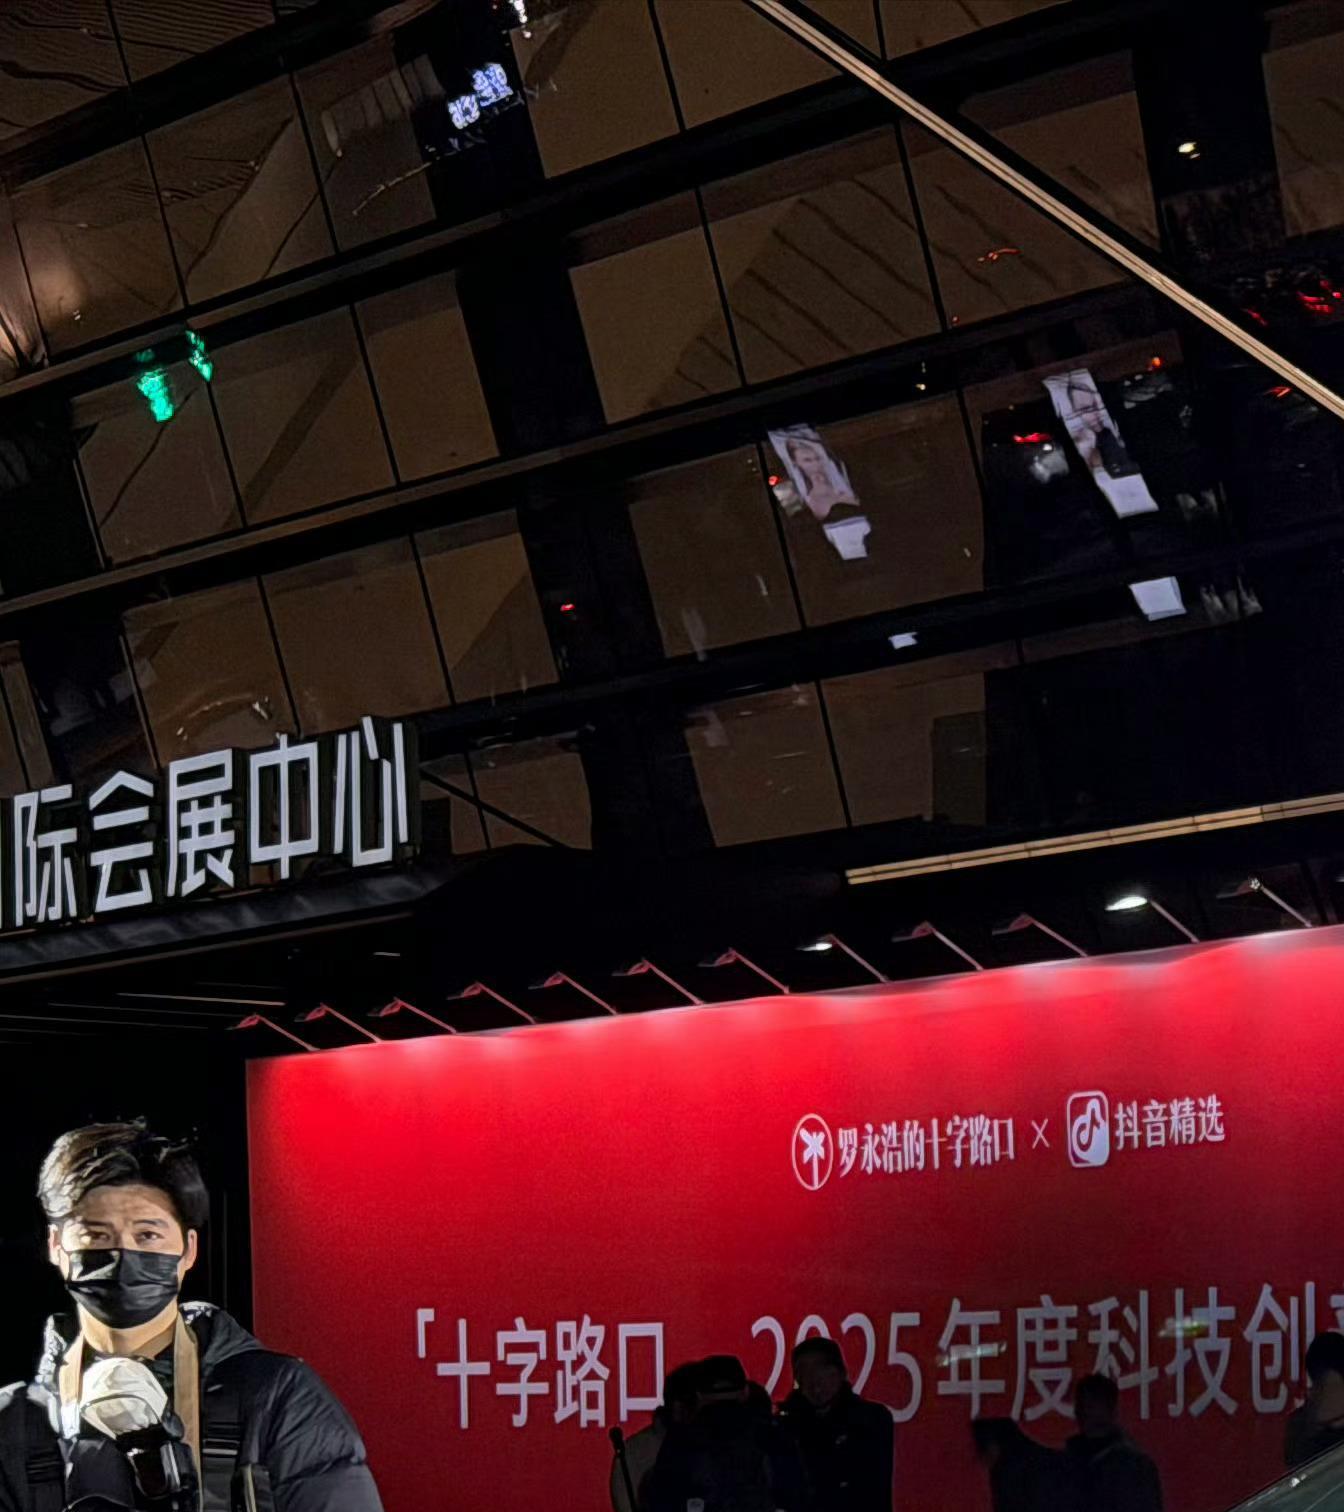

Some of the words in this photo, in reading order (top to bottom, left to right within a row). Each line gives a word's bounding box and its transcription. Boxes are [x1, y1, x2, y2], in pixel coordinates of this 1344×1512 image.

[0, 715, 408, 928] 际会展中心
[838, 1114, 1015, 1178] 罗永浩的十字路口
[1114, 1094, 1226, 1151] 抖音精选
